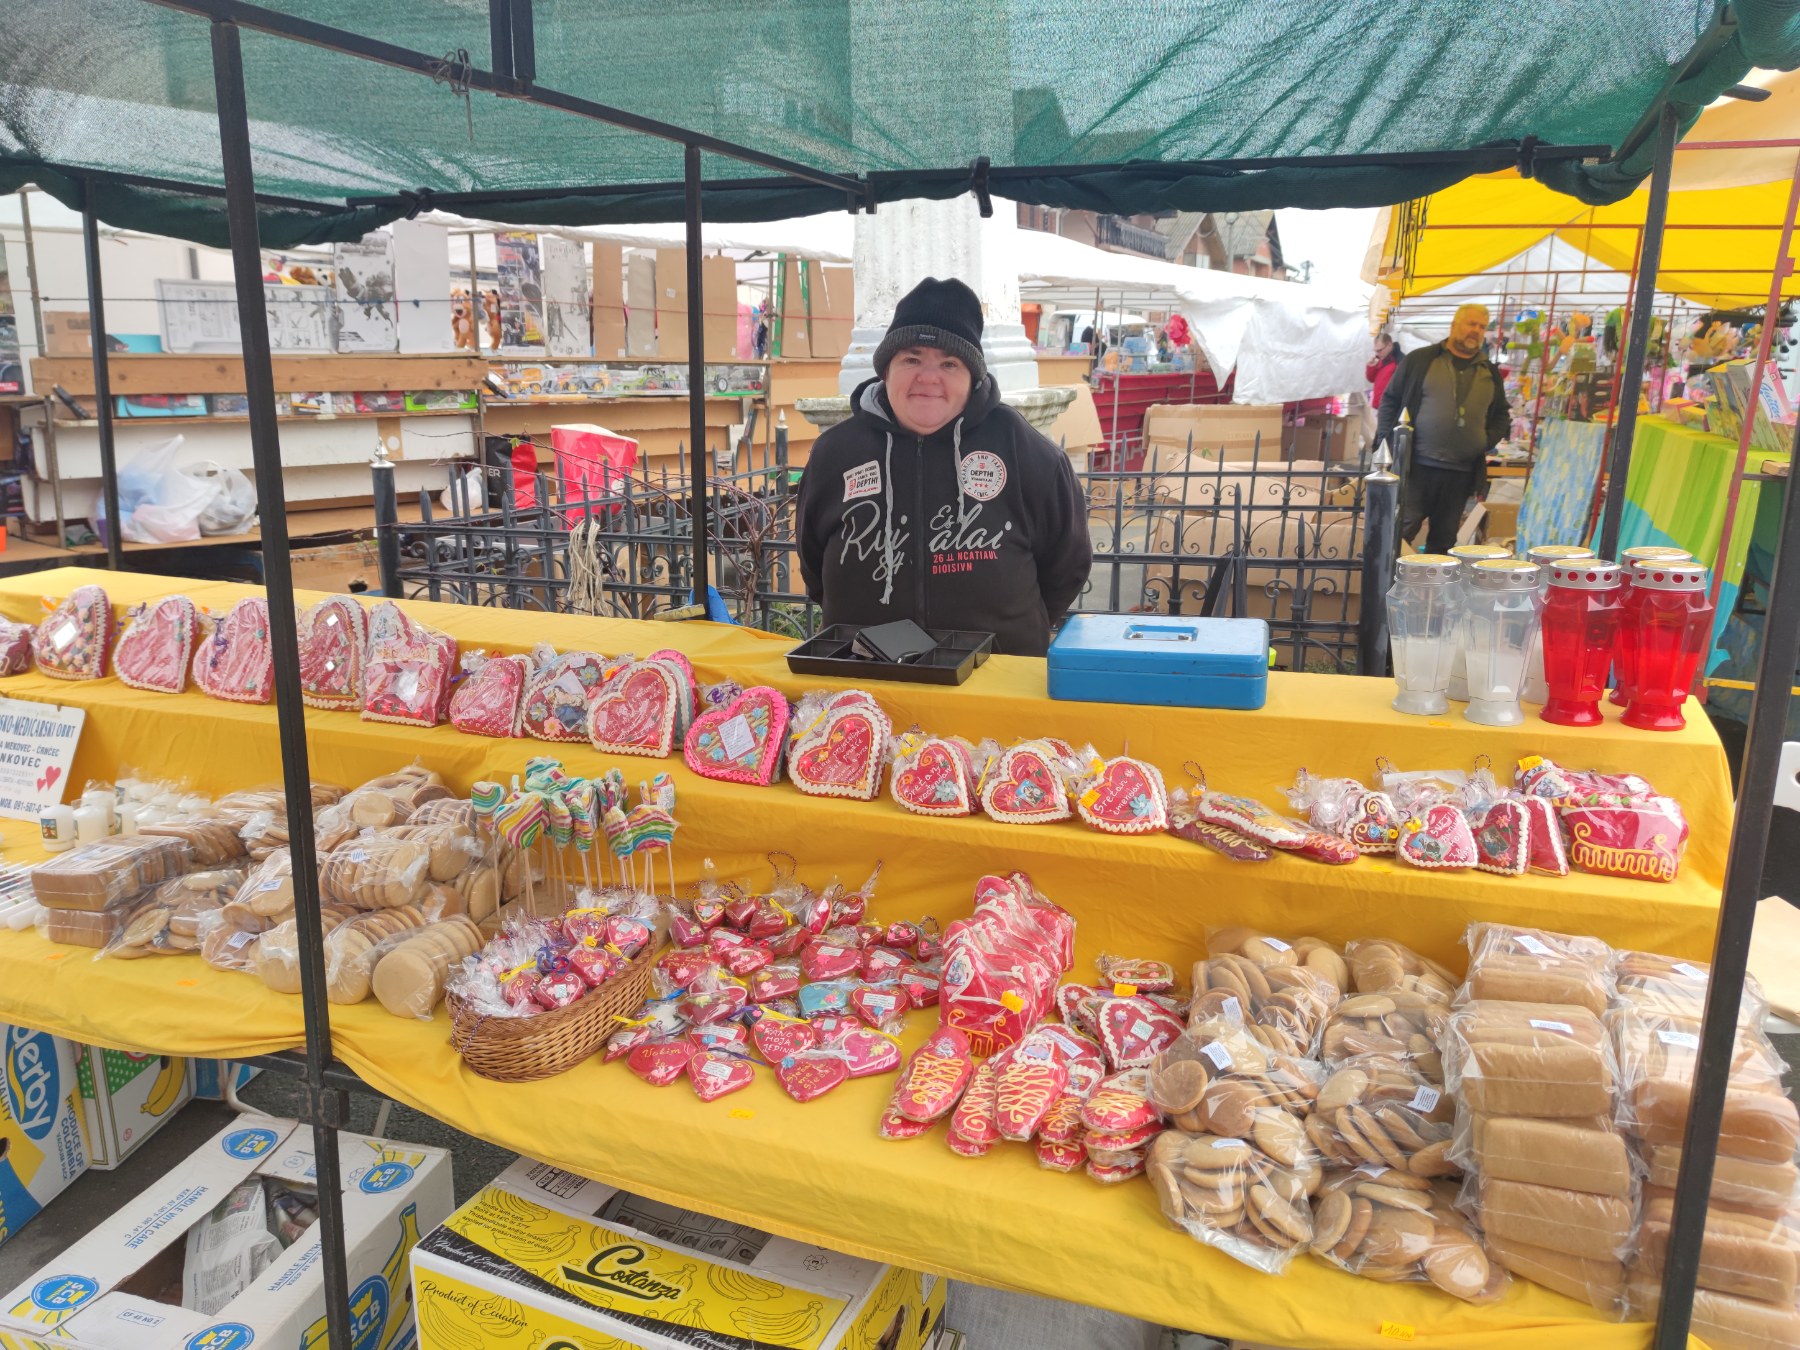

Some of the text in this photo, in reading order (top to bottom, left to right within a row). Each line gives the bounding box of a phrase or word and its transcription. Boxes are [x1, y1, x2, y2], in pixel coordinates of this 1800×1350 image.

[933, 553, 944, 564] 26
[56, 723, 76, 738] OBRT
[1093, 780, 1128, 814] Sretan
[65, 1094, 84, 1168] PRODUCE OF
[239, 1134, 265, 1154] SCB
[60, 1116, 77, 1179] COLOMBIA
[372, 1167, 397, 1188] SCB
[128, 1186, 209, 1249] HANDLE WITH CARE
[473, 1205, 489, 1214] Store
[478, 1200, 524, 1221] Handle with care
[462, 1215, 482, 1228] applied
[491, 1227, 527, 1244] preservation
[267, 1263, 301, 1291] HANDLE
[586, 1245, 682, 1300] Costanza
[51, 1281, 85, 1304] SCB
[420, 1280, 529, 1328] Product of Ecuador
